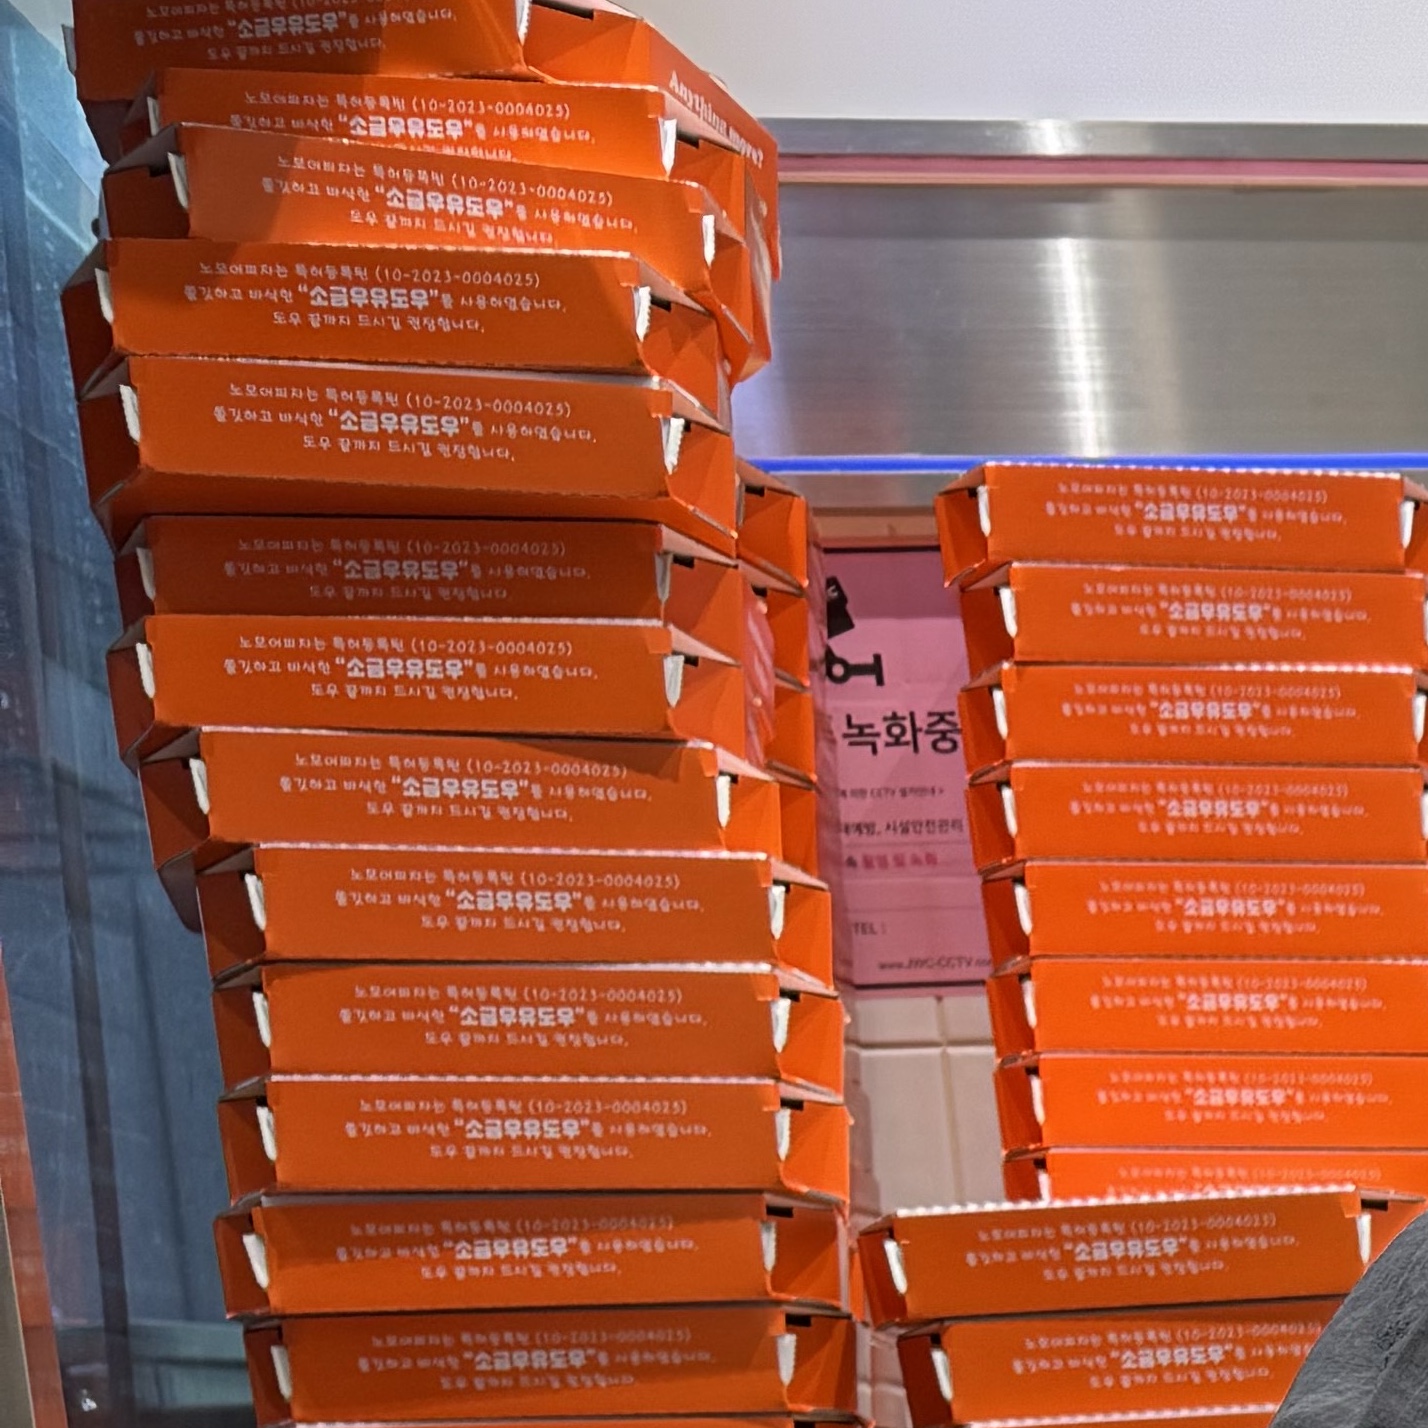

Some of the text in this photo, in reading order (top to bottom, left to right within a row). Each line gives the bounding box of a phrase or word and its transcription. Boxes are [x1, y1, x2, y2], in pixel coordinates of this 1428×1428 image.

[452, 175, 614, 207] (10-2023-0004025)
[375, 268, 540, 289] (10-2023-0004025)
[406, 393, 571, 418] (10-2023-0004025)
[411, 640, 572, 657] (10-2023-0004025)
[842, 710, 963, 757] 녹화중
